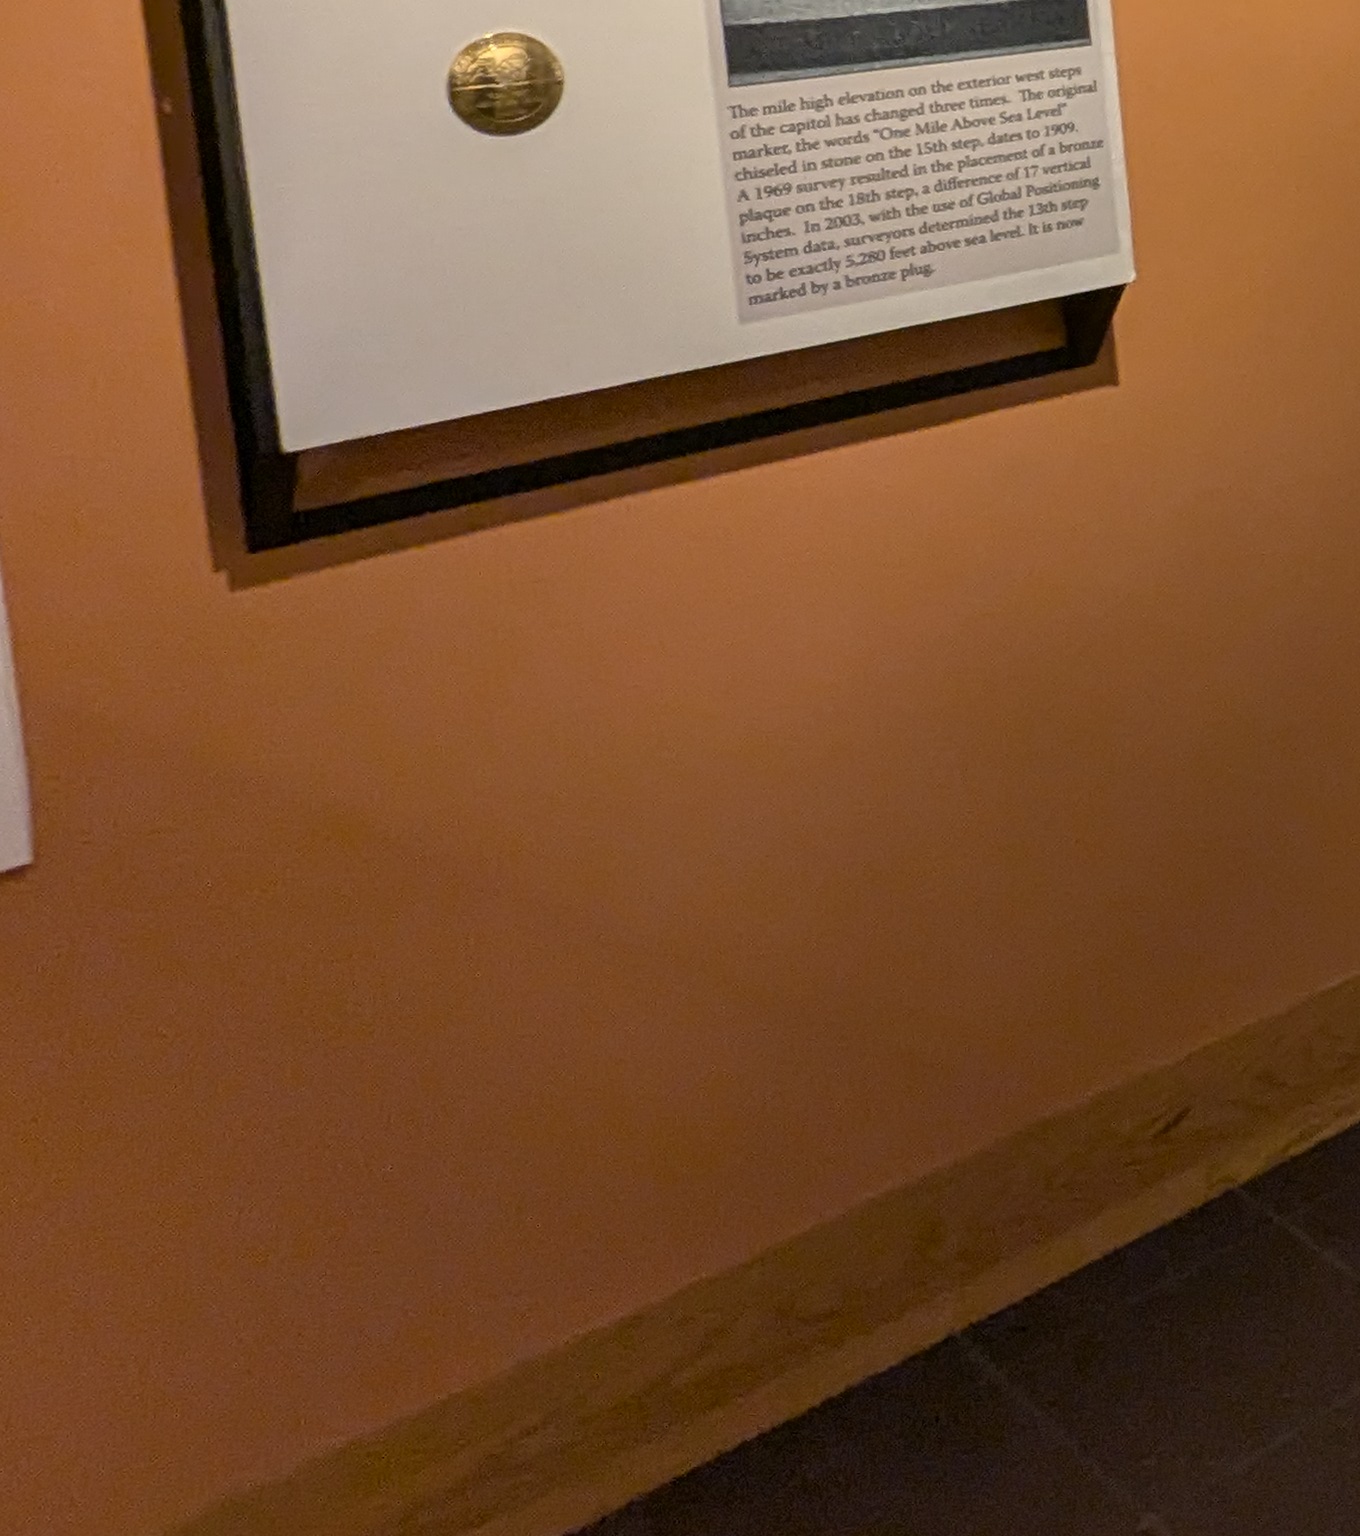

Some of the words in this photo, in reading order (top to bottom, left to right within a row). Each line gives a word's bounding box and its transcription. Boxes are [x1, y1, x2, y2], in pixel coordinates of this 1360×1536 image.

[726, 103, 760, 121] The
[762, 98, 797, 117] mile
[798, 92, 835, 114] high
[837, 88, 905, 107] elevation
[907, 85, 928, 98] on
[930, 78, 954, 96] the
[956, 74, 1012, 92] exterior
[1014, 69, 1046, 84] west
[1048, 66, 1082, 82] steps
[747, 281, 808, 307] marked
[809, 279, 829, 297] by
[832, 279, 842, 292] a
[843, 269, 898, 289] bronze
